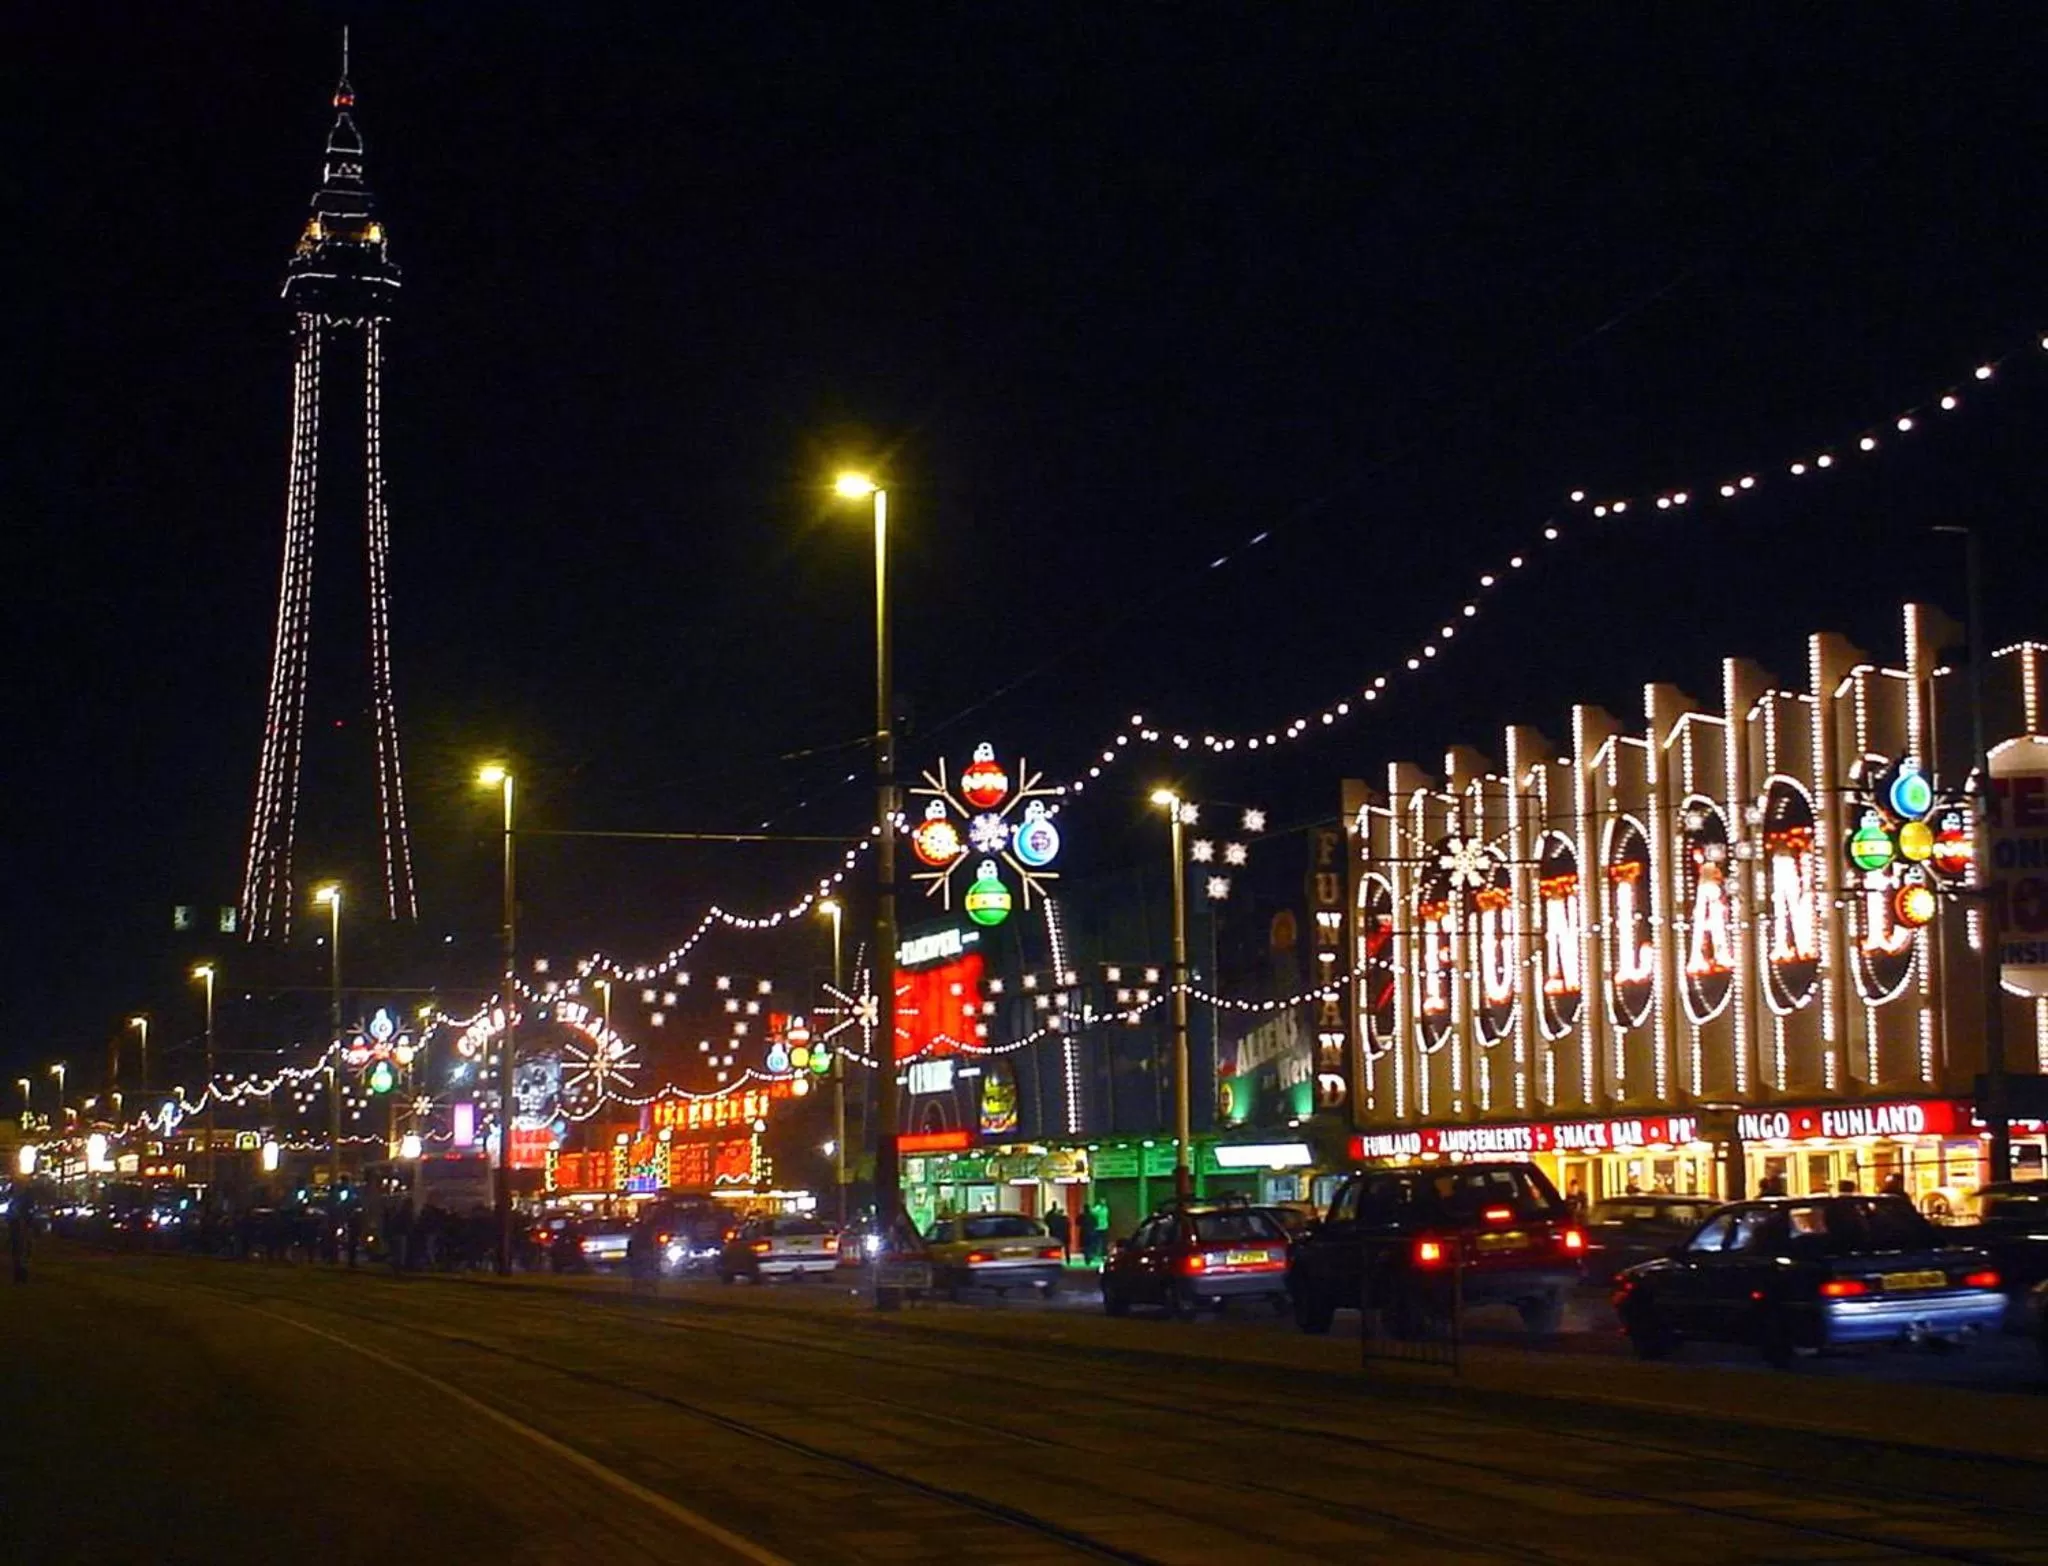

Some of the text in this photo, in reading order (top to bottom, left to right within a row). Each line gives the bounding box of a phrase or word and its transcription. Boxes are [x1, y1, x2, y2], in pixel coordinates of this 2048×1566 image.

[1363, 1132, 1422, 1158] FUNLAND
[1438, 1126, 1533, 1152] AMUSEMENTS
[1552, 1122, 1608, 1148] SNACK
[1610, 1119, 1645, 1146] BAR
[1737, 1111, 1791, 1141] INGO
[1821, 1103, 1925, 1138] FUNLAND
